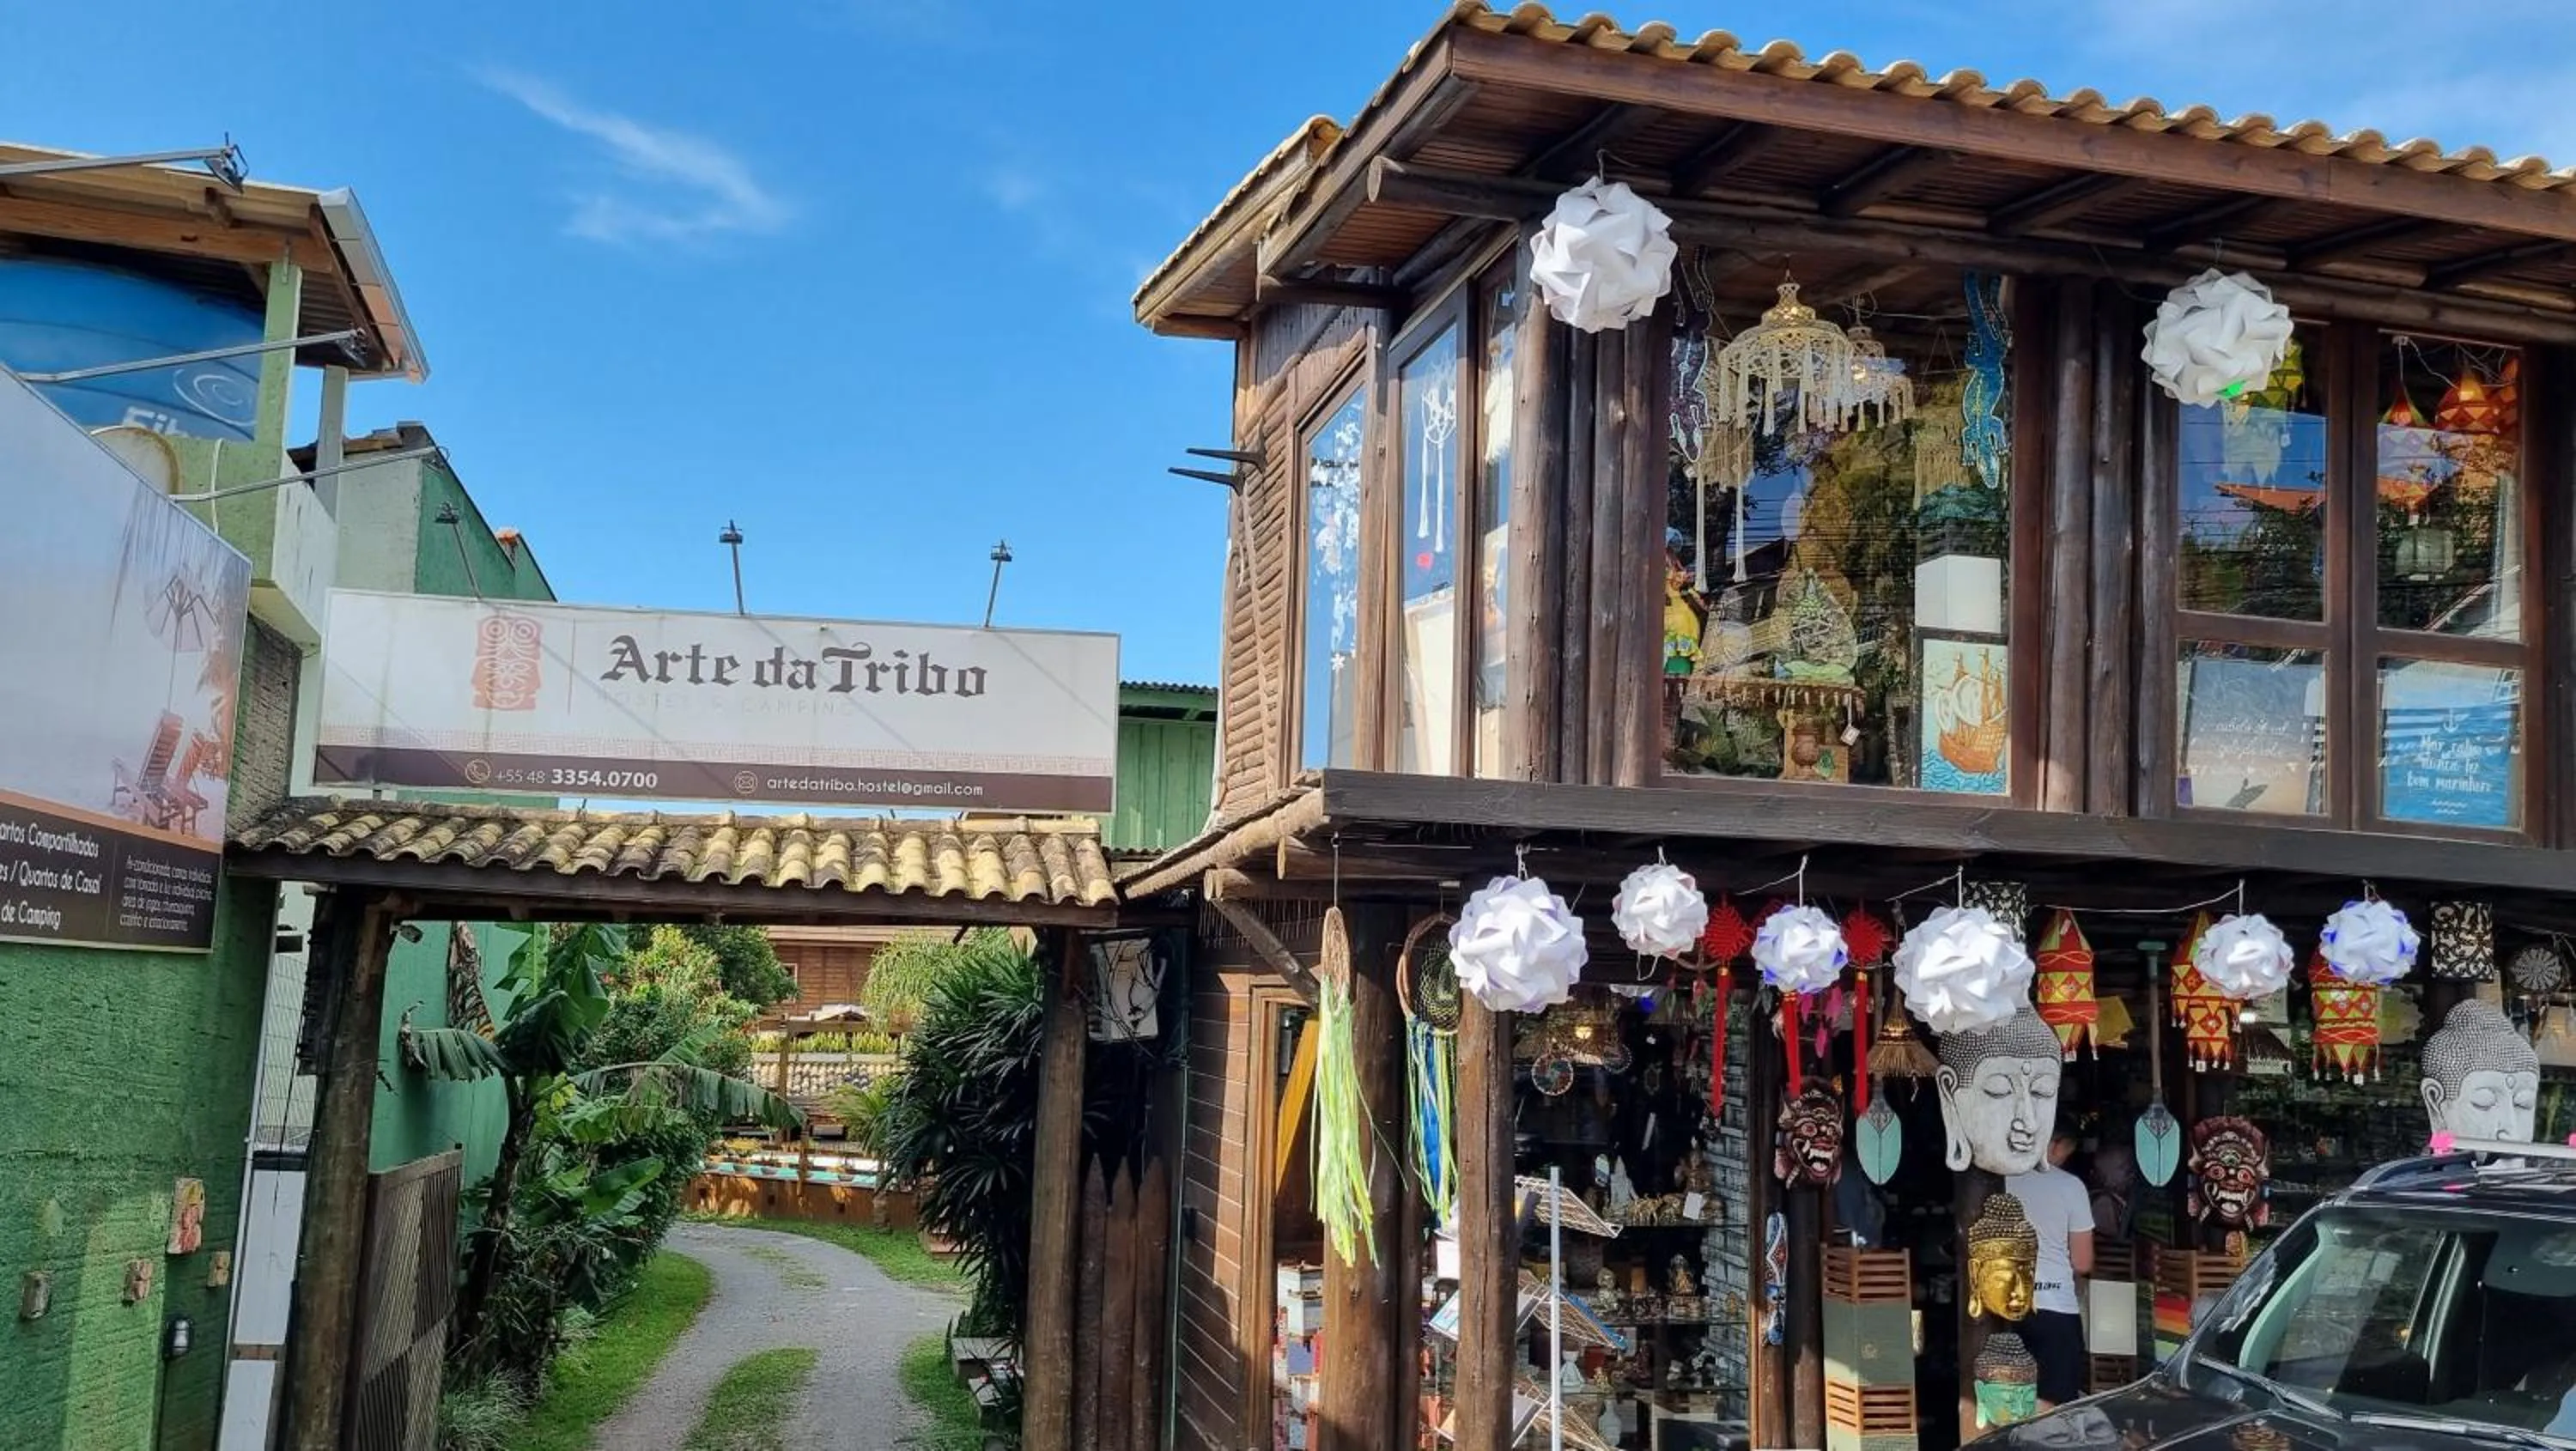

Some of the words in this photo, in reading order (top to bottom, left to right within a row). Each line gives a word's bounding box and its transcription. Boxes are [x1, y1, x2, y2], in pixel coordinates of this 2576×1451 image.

[600, 634, 741, 686] Arte
[752, 647, 817, 690] da
[822, 641, 988, 697] Tribo
[495, 769, 523, 783] +55
[526, 770, 546, 784] 48
[551, 768, 658, 788] 3354.0700
[767, 776, 984, 797] artedatribo.hostel@gmail.com
[28, 823, 99, 857] Compartilhados
[20, 861, 58, 888] Quartos
[61, 869, 73, 889] de
[76, 870, 102, 893] Casal
[1, 900, 15, 922] de
[19, 901, 61, 930] Camping
